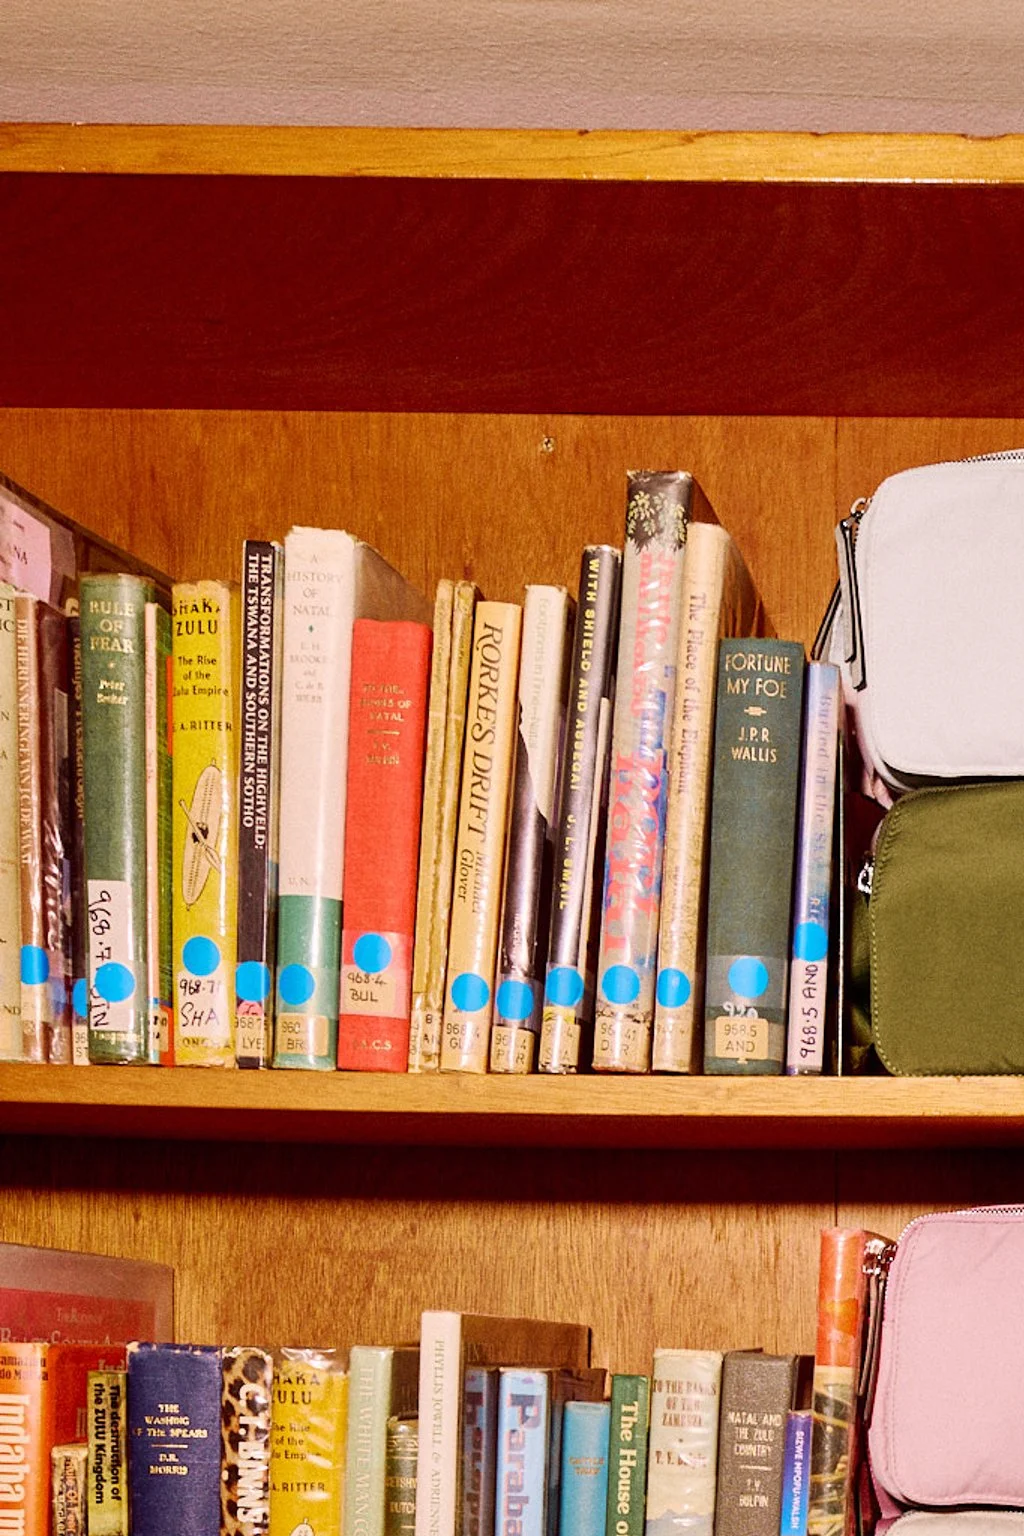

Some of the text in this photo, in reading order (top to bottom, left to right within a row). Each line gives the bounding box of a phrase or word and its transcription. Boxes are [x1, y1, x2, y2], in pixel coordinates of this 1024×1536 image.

[87, 599, 136, 618] RULE
[99, 619, 125, 634] OF
[176, 620, 218, 636] ZULU
[88, 636, 135, 655] FEAR
[725, 652, 792, 674] FORTUNE
[243, 553, 258, 828] THE TSWANA AND SOUTHERN SOTHO
[727, 678, 787, 698] MY FOE
[254, 554, 272, 850] TRANSFORMATIONS ON THE HIGHVELD:
[731, 745, 778, 763] WALLIS
[725, 1038, 756, 1053] AND
[619, 1402, 637, 1443] The
[617, 1448, 637, 1516] House
